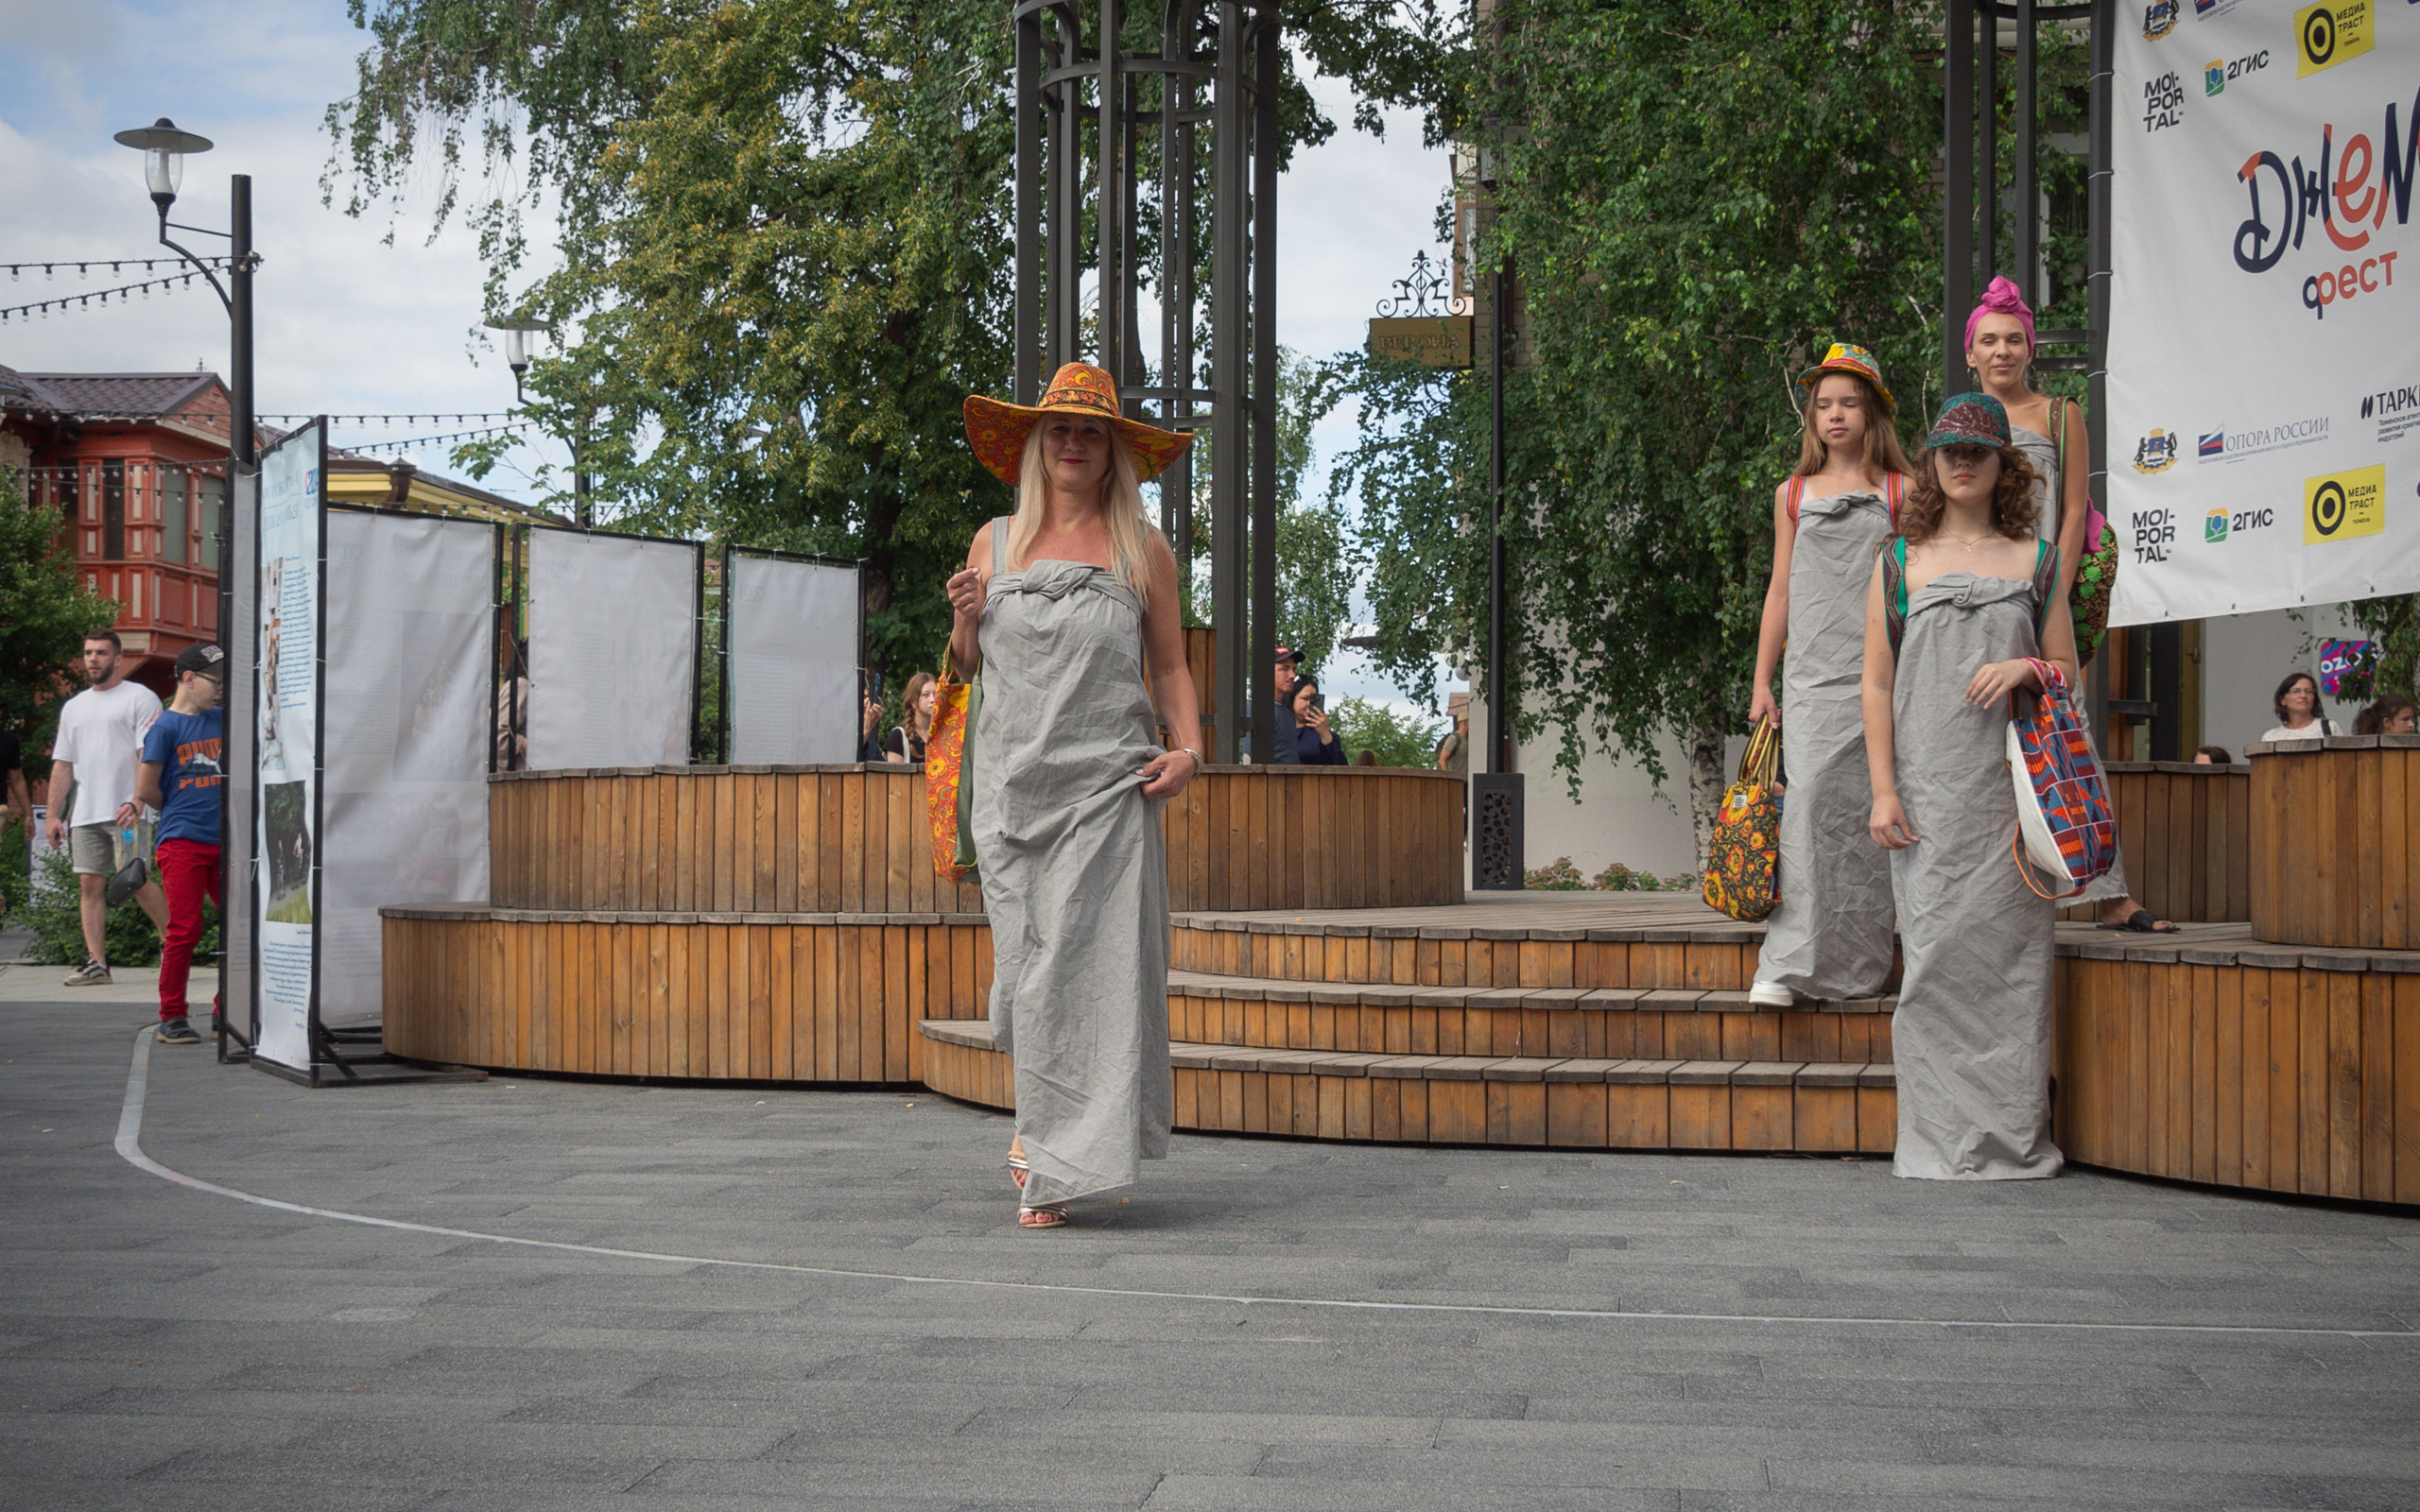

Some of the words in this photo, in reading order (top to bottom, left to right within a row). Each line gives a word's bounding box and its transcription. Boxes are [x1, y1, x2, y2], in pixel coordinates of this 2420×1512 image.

[2336, 2, 2366, 22] МЕДИА
[2338, 15, 2364, 34] ТРАСТ
[2227, 50, 2269, 81] 2ГИС
[2147, 87, 2184, 115] POR
[1379, 335, 1459, 350] ВЕРОНА
[2376, 385, 2420, 415] ТАРК
[2226, 429, 2271, 452] ОПОРА
[2273, 416, 2329, 442] РОССИИ
[2347, 484, 2377, 498] МЕДИА
[2349, 497, 2375, 510] ТРАСТ
[2232, 508, 2273, 532] 2ГИС
[2135, 525, 2175, 546] POR
[177, 737, 222, 767] PUM
